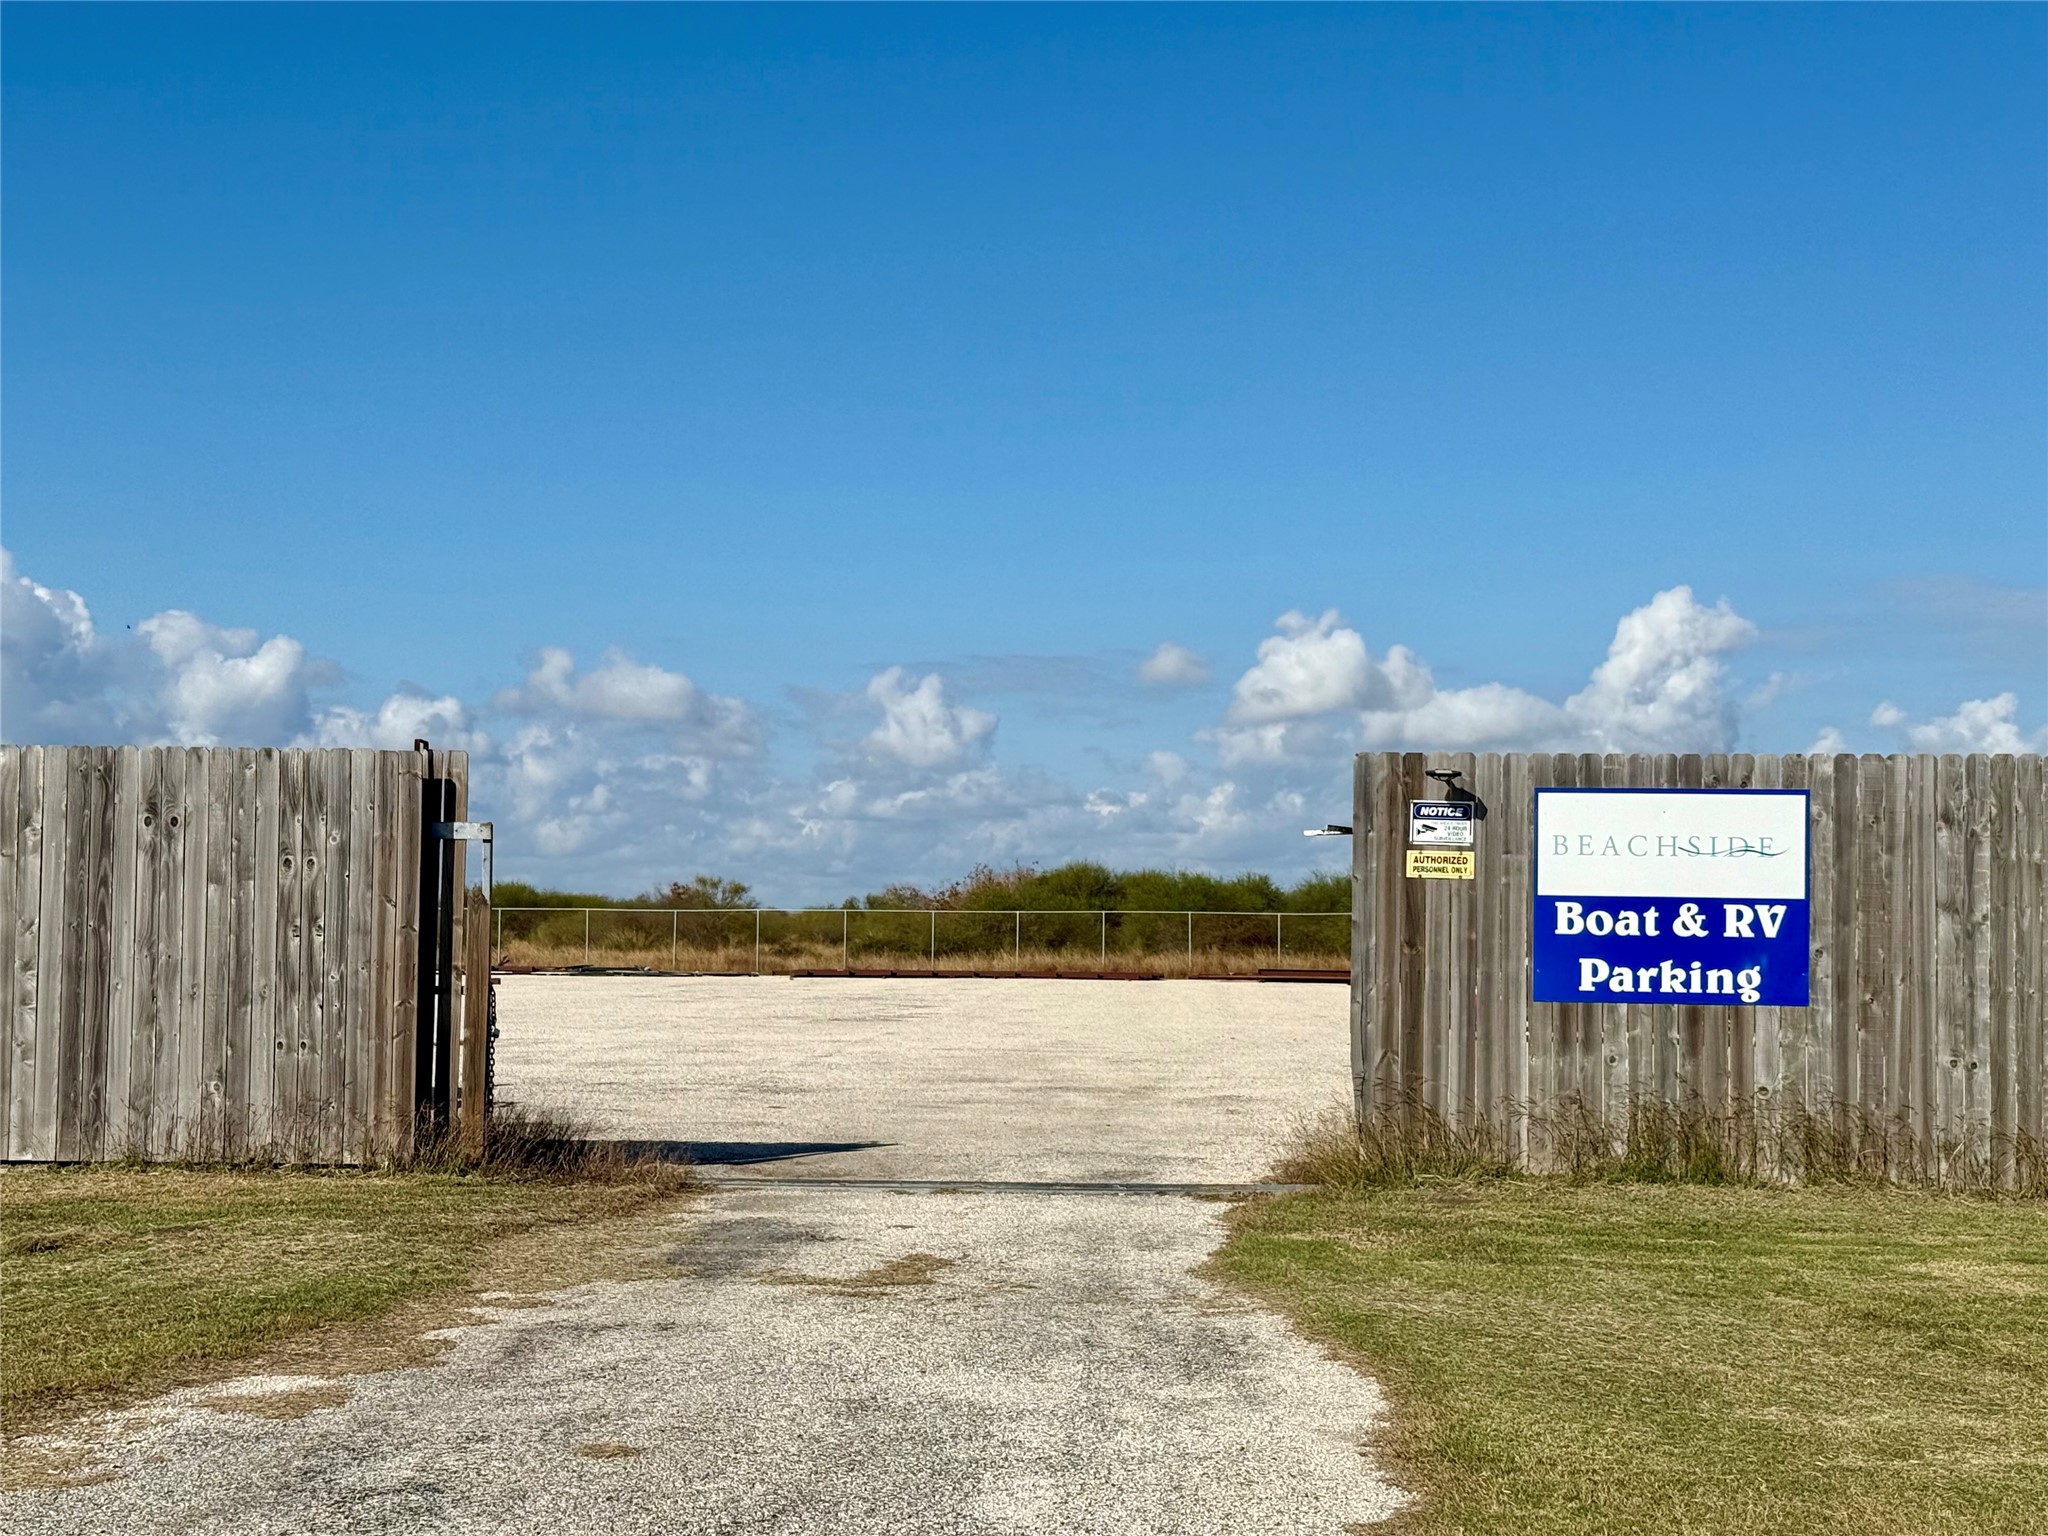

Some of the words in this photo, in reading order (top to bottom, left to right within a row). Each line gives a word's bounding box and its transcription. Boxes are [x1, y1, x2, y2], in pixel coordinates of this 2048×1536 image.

[1420, 807, 1463, 816] NOTICE
[1552, 835, 1774, 857] BEACHSIDE
[1413, 856, 1468, 865] AUTHORIZED
[1451, 866, 1468, 874] ONLY
[1554, 901, 1660, 937] Boat
[1672, 902, 1709, 938] &
[1723, 903, 1788, 938] RV
[1578, 957, 1762, 1003] Parking
